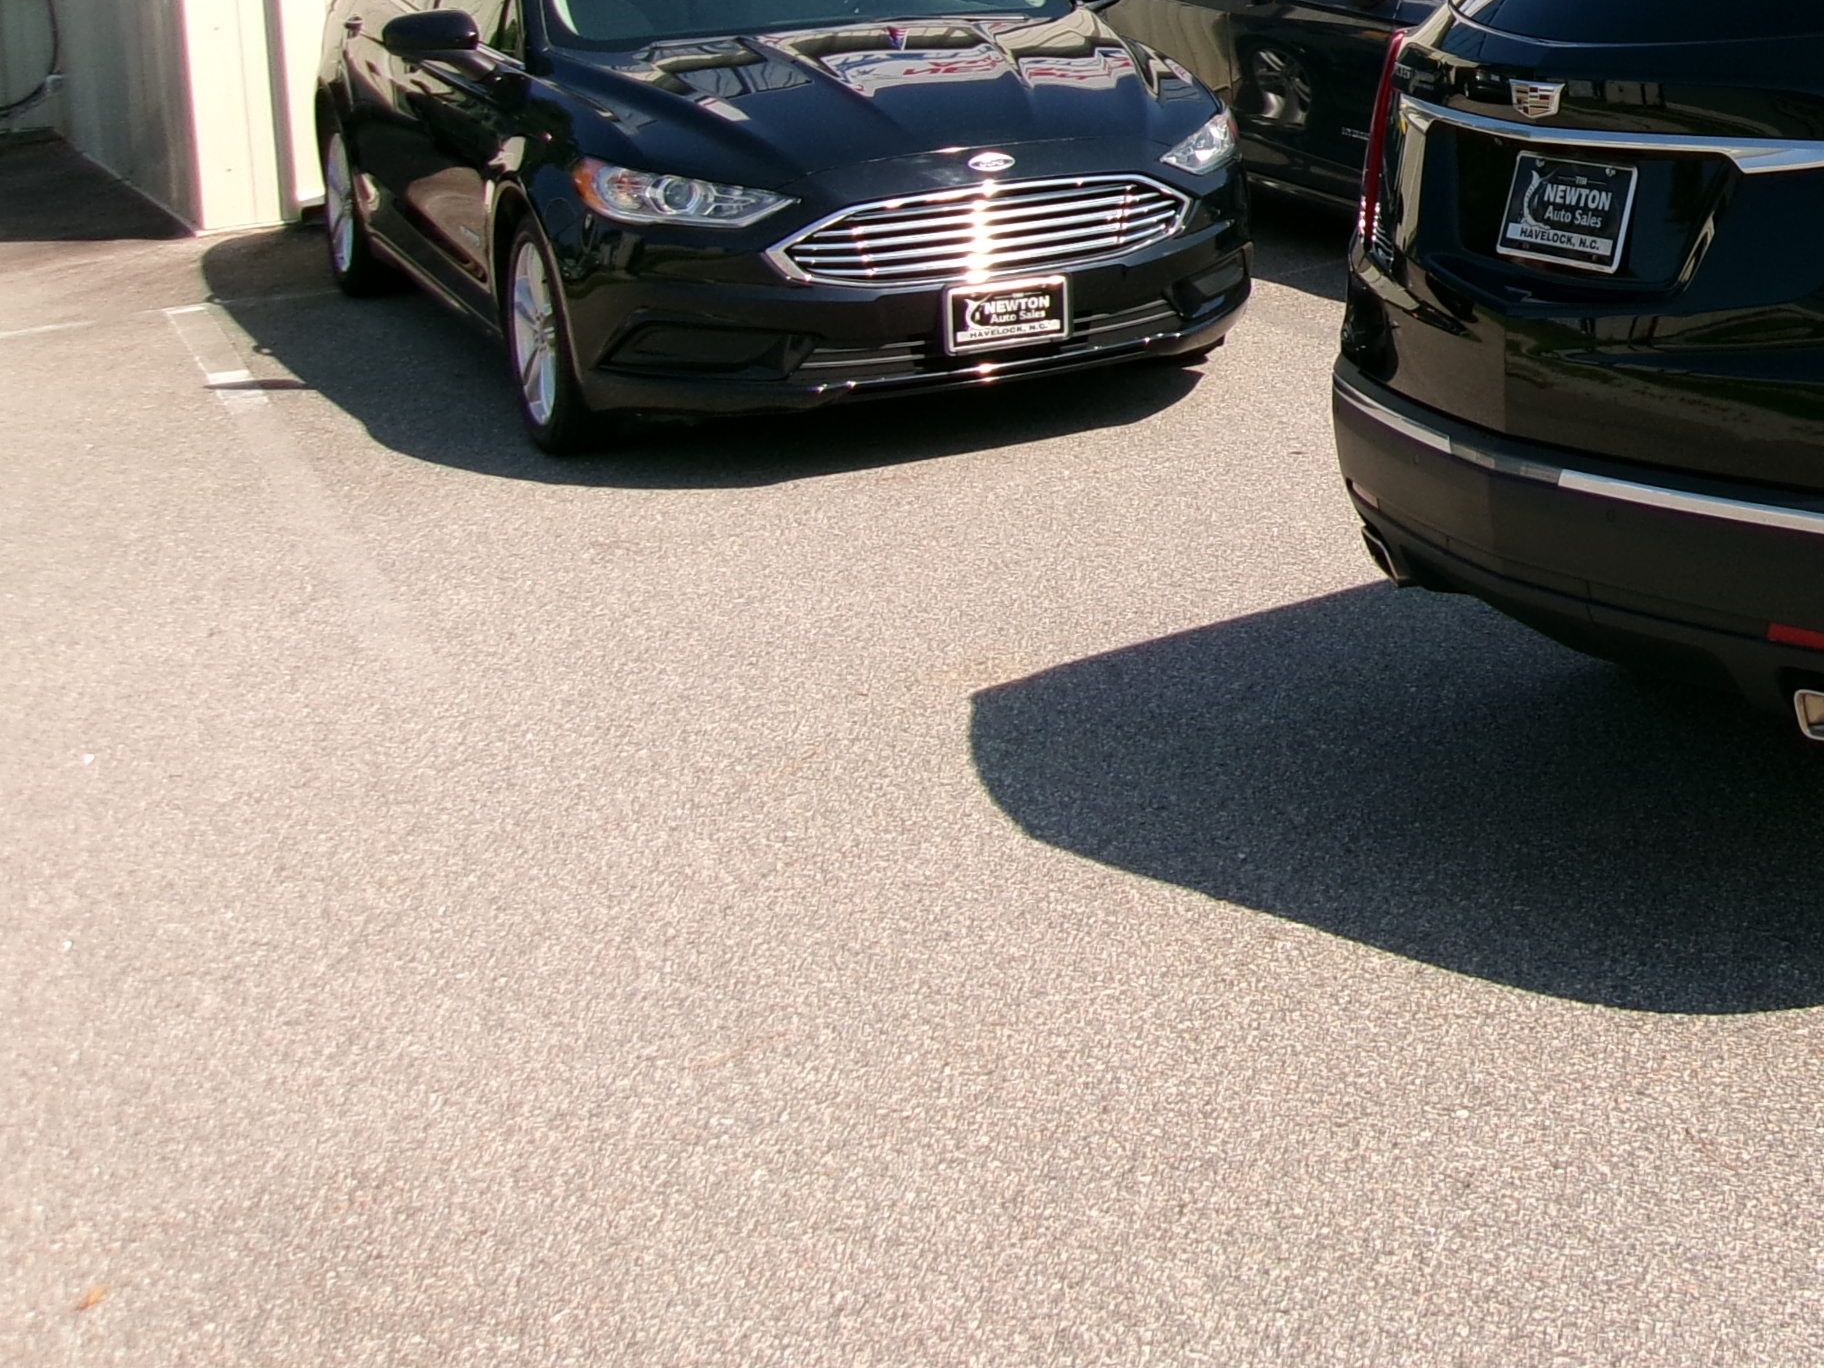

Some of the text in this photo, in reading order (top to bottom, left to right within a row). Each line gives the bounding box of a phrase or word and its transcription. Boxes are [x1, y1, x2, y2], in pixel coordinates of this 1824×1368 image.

[1543, 183, 1612, 211] NEWTON
[1544, 205, 1602, 228] Auto Sales
[1519, 227, 1600, 251] HAVELOCK, N.C.
[984, 295, 1050, 314] NEWTON
[989, 309, 1046, 324] Auto Sales
[970, 323, 1048, 338] HAVELOCK, N.C.
